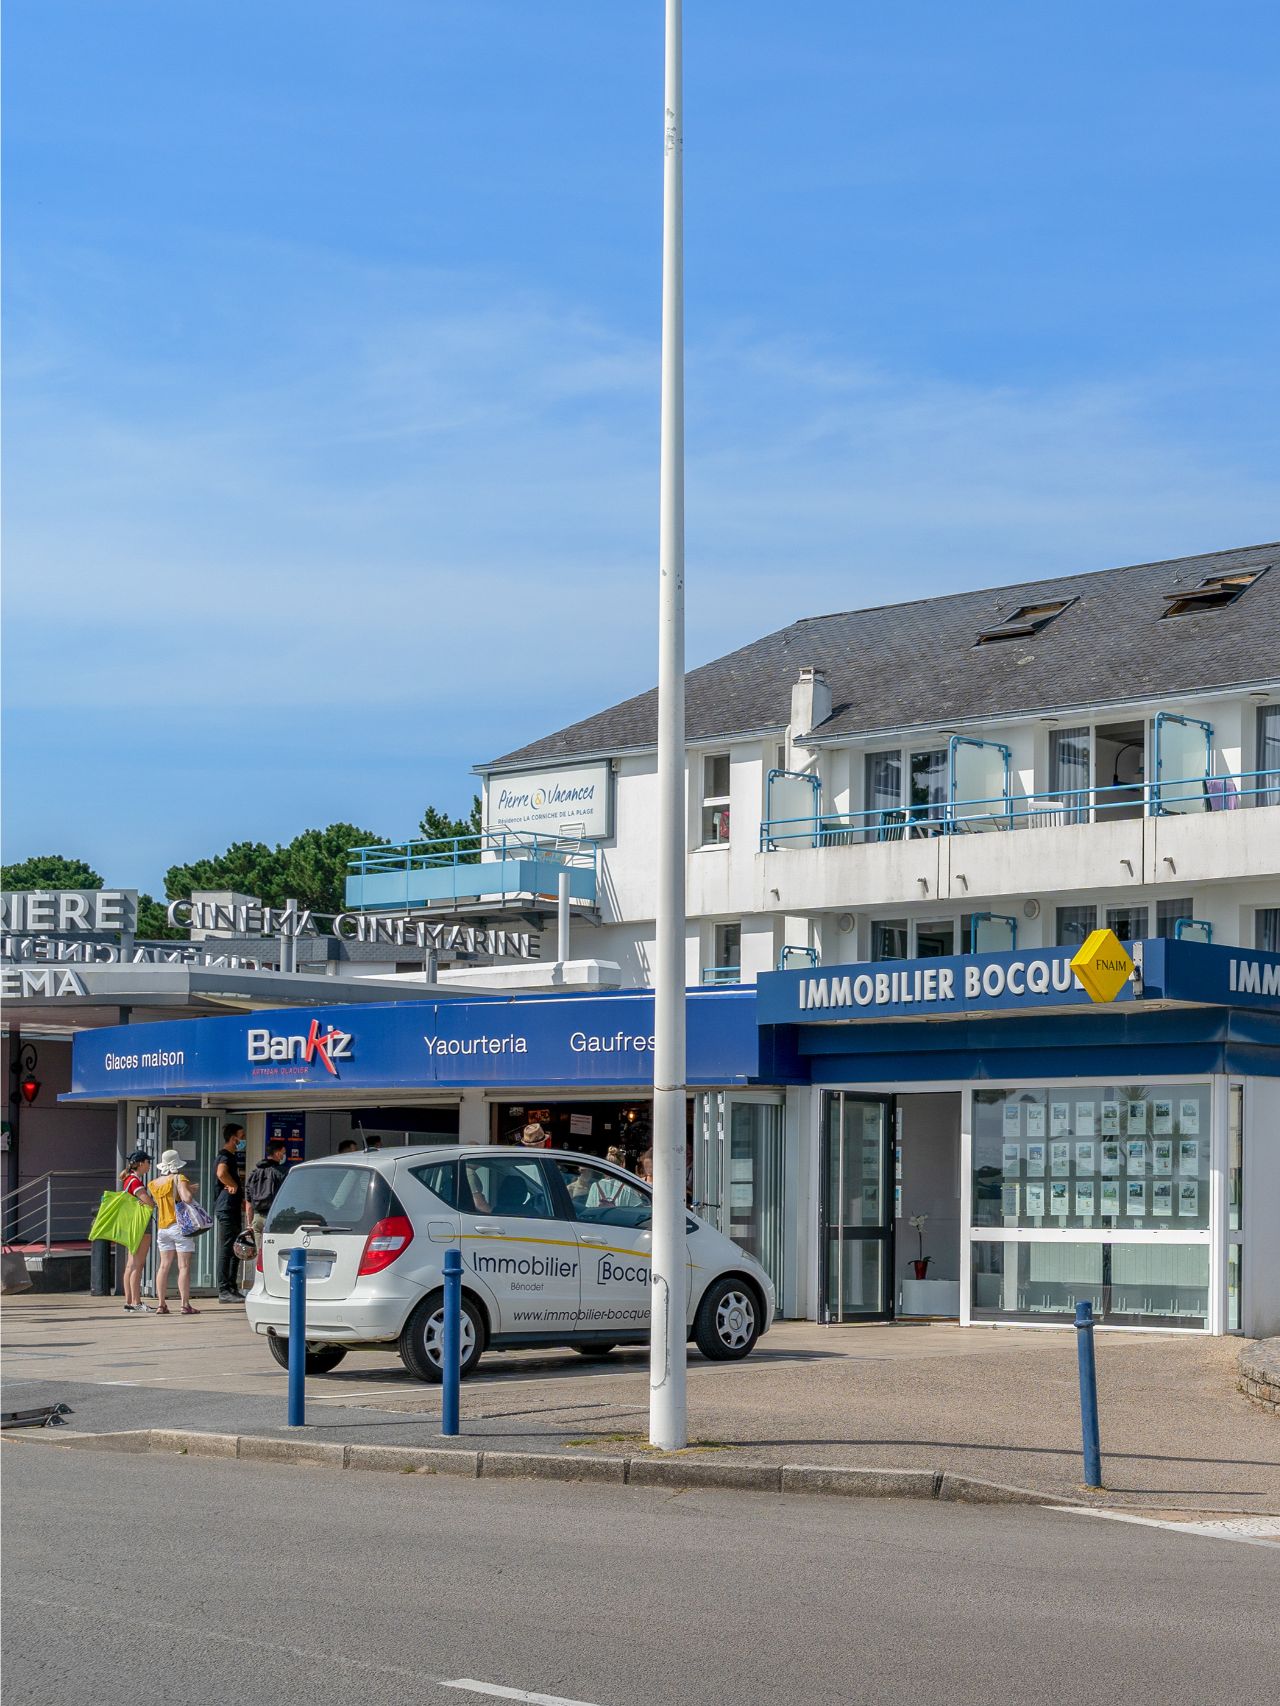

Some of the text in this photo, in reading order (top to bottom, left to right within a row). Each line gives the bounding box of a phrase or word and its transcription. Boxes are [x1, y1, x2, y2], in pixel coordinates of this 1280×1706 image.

[498, 789, 529, 810] Pierre
[548, 784, 595, 804] Vacances
[531, 812, 558, 820] CORNICHE
[576, 808, 594, 816] PLAGE
[168, 899, 541, 959] CINÉMA CINÉMARINE
[1096, 960, 1127, 972] FNAIM
[799, 958, 1087, 1010] IMMOBILIER BOCQU
[424, 1034, 528, 1055] Yaourteria
[105, 1049, 184, 1071] Glaces maison
[473, 1252, 579, 1278] Immobilier
[510, 1282, 545, 1291] Bénodet
[513, 1308, 651, 1322] www.immobilier-bocque
